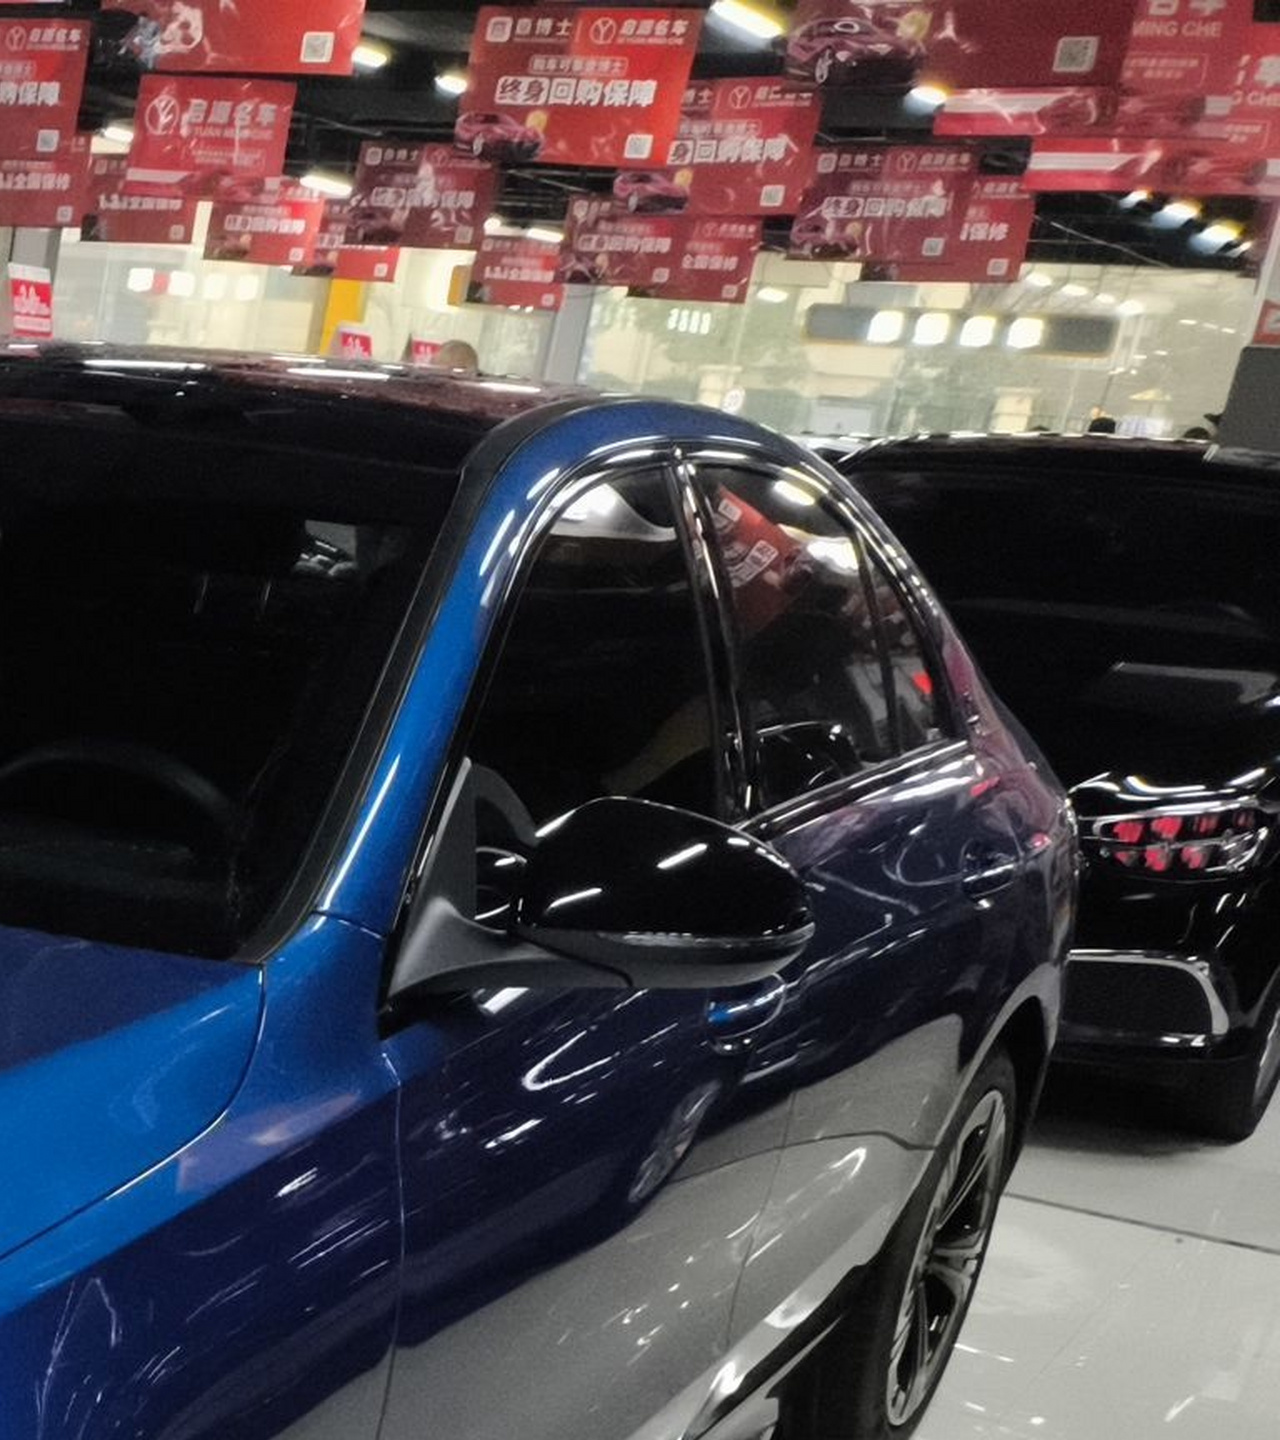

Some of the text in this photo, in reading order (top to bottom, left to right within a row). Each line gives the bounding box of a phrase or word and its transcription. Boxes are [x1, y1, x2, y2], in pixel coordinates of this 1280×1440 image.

[495, 76, 657, 106] 终身回购保障
[959, 223, 1009, 241] 保修
